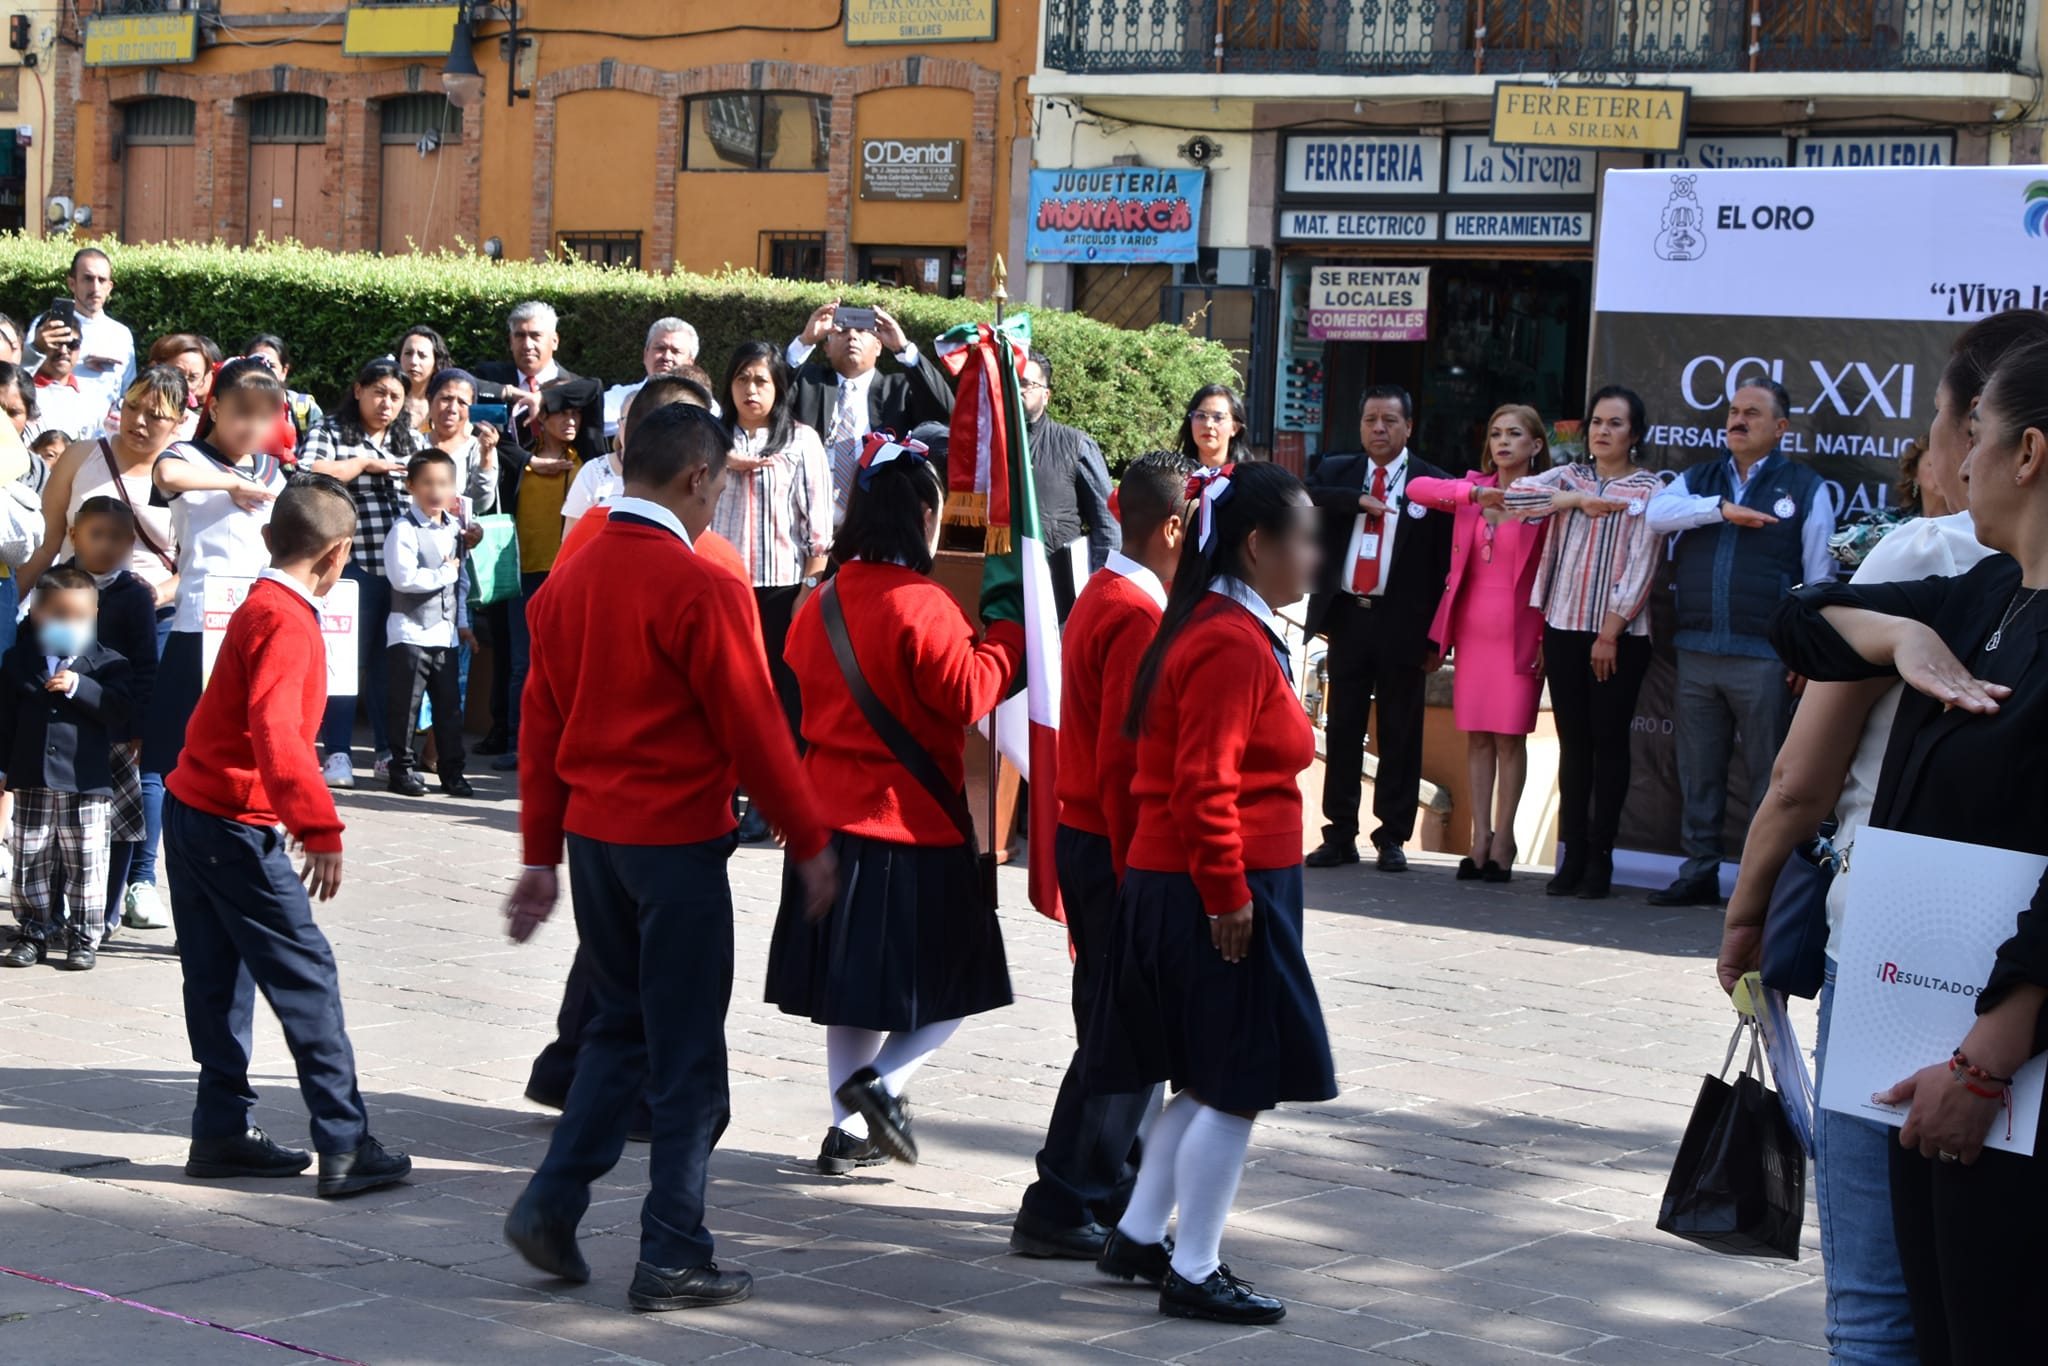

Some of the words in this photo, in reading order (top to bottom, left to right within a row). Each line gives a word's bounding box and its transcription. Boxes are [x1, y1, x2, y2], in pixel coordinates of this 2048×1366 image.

[899, 24, 942, 36] SIMILARES
[1506, 94, 1673, 120] FERRETERIA
[1533, 121, 1556, 136] LA
[1568, 122, 1639, 140] SIRENA
[864, 141, 953, 163] O'Dental
[1194, 143, 1203, 158] 5
[1305, 143, 1423, 182] FERRETERIA
[1463, 144, 1493, 182] La
[1500, 146, 1582, 191] Sirena
[1037, 197, 1193, 233] MONARCA
[1293, 214, 1329, 235] MAT.
[1337, 214, 1426, 236] ELECTRICO
[1455, 215, 1583, 236] HERRAMIENTAS
[1717, 206, 1747, 229] EL
[1752, 206, 1815, 231] ORO
[1121, 234, 1159, 246] VARIOS
[1319, 271, 1342, 287] SE
[1347, 271, 1421, 287] RENTAN
[1324, 290, 1413, 307] LOCALES
[1311, 312, 1424, 329] COMERCIALES
